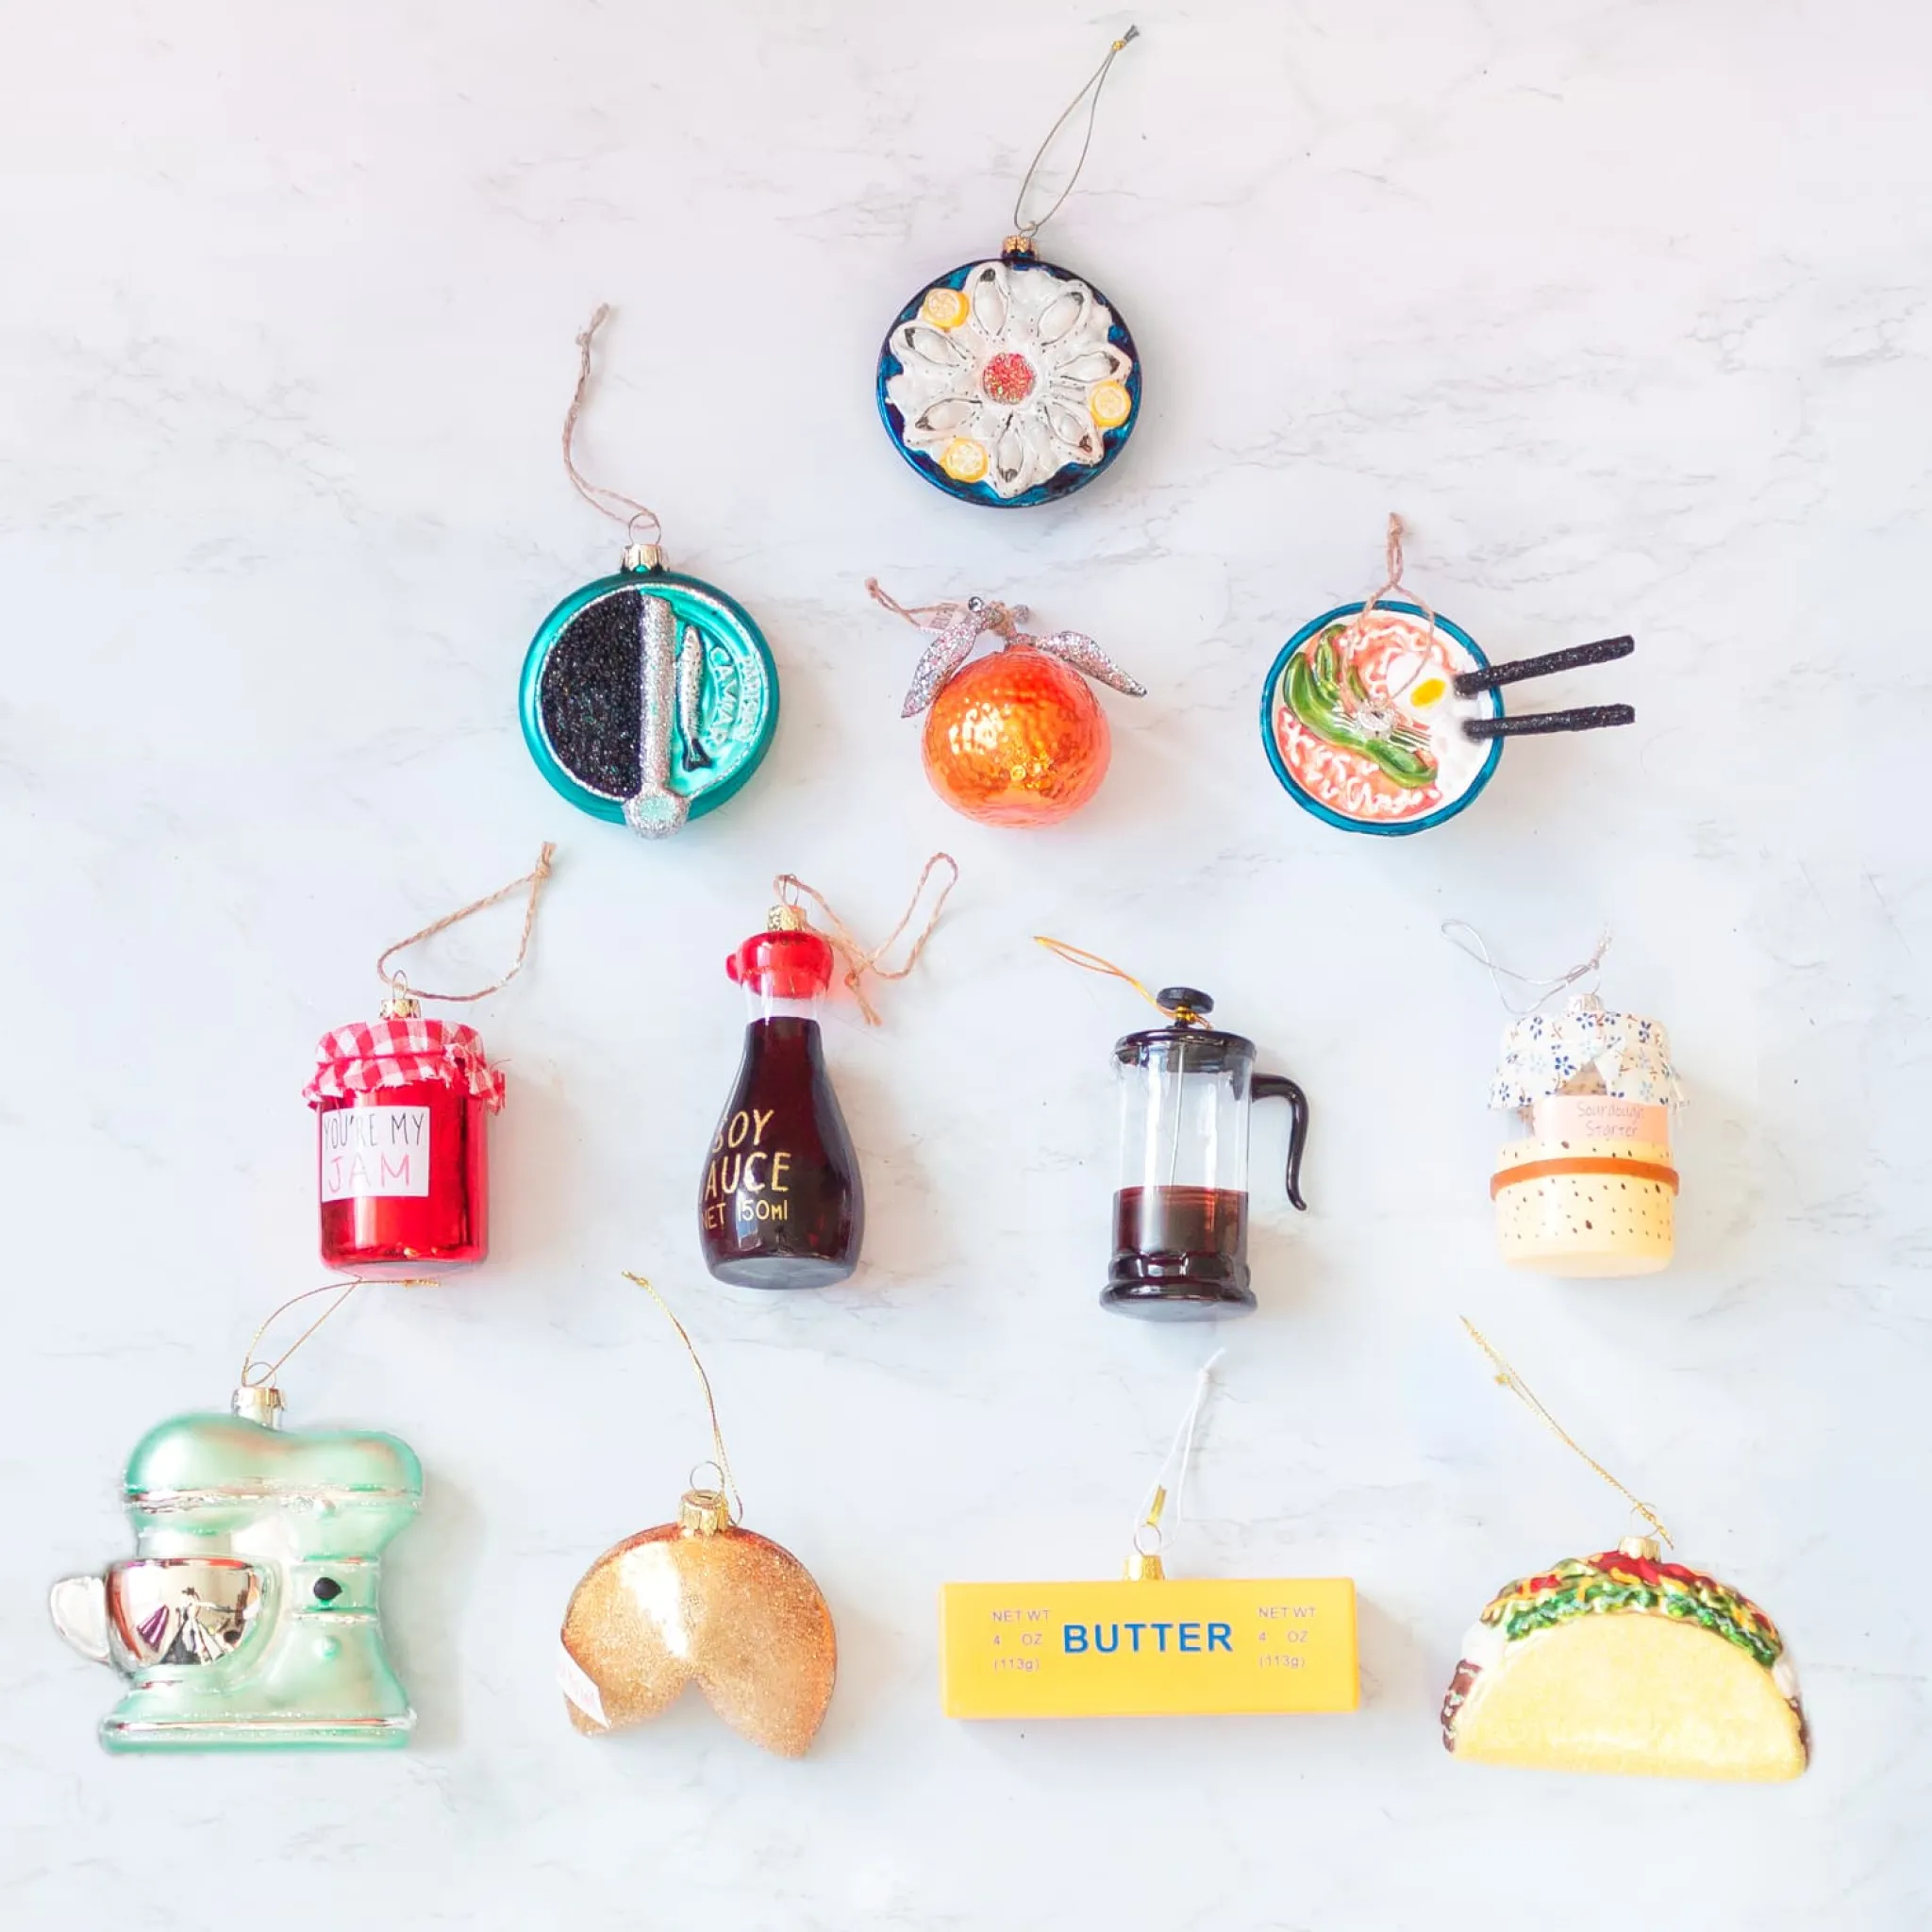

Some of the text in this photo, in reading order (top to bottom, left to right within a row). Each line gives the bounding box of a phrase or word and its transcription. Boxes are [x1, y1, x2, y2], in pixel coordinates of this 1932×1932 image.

[708, 646, 738, 745] CAVIAR
[324, 1112, 425, 1150] YOU'RE MY
[1586, 1120, 1639, 1137] Starter
[328, 1151, 409, 1193] JAM
[705, 1151, 791, 1201] AUCE
[992, 1609, 1050, 1623] NET WT
[1258, 1606, 1316, 1619] NET WT
[993, 1633, 1042, 1646] 4 OZ
[1063, 1623, 1233, 1653] BUTTER
[1258, 1629, 1308, 1643] 4 OZ
[994, 1657, 1040, 1673] (113g)
[1259, 1655, 1306, 1670] (113g)
